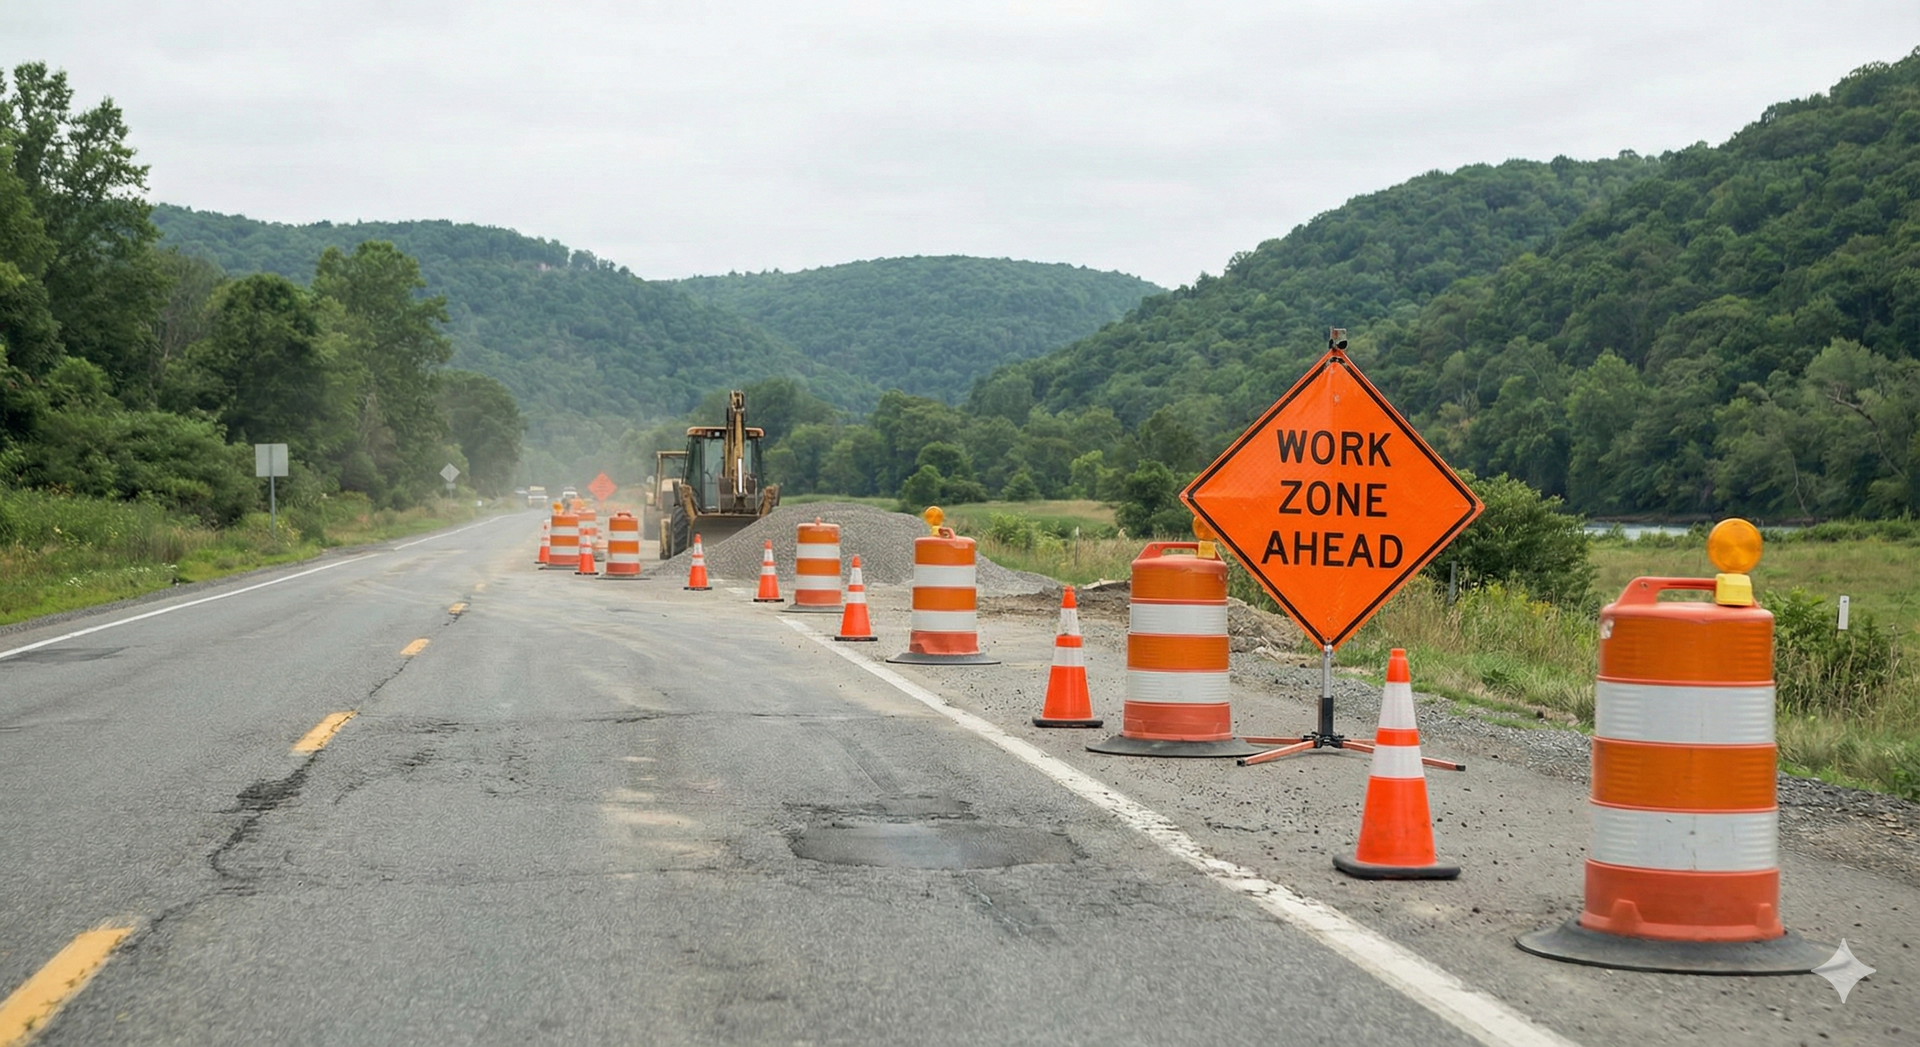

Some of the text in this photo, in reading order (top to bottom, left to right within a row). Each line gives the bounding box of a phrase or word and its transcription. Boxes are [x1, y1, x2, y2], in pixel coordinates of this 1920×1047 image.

[1277, 430, 1391, 467] WORK
[1279, 481, 1387, 517] ZONE
[1261, 531, 1403, 568] AHEAD
